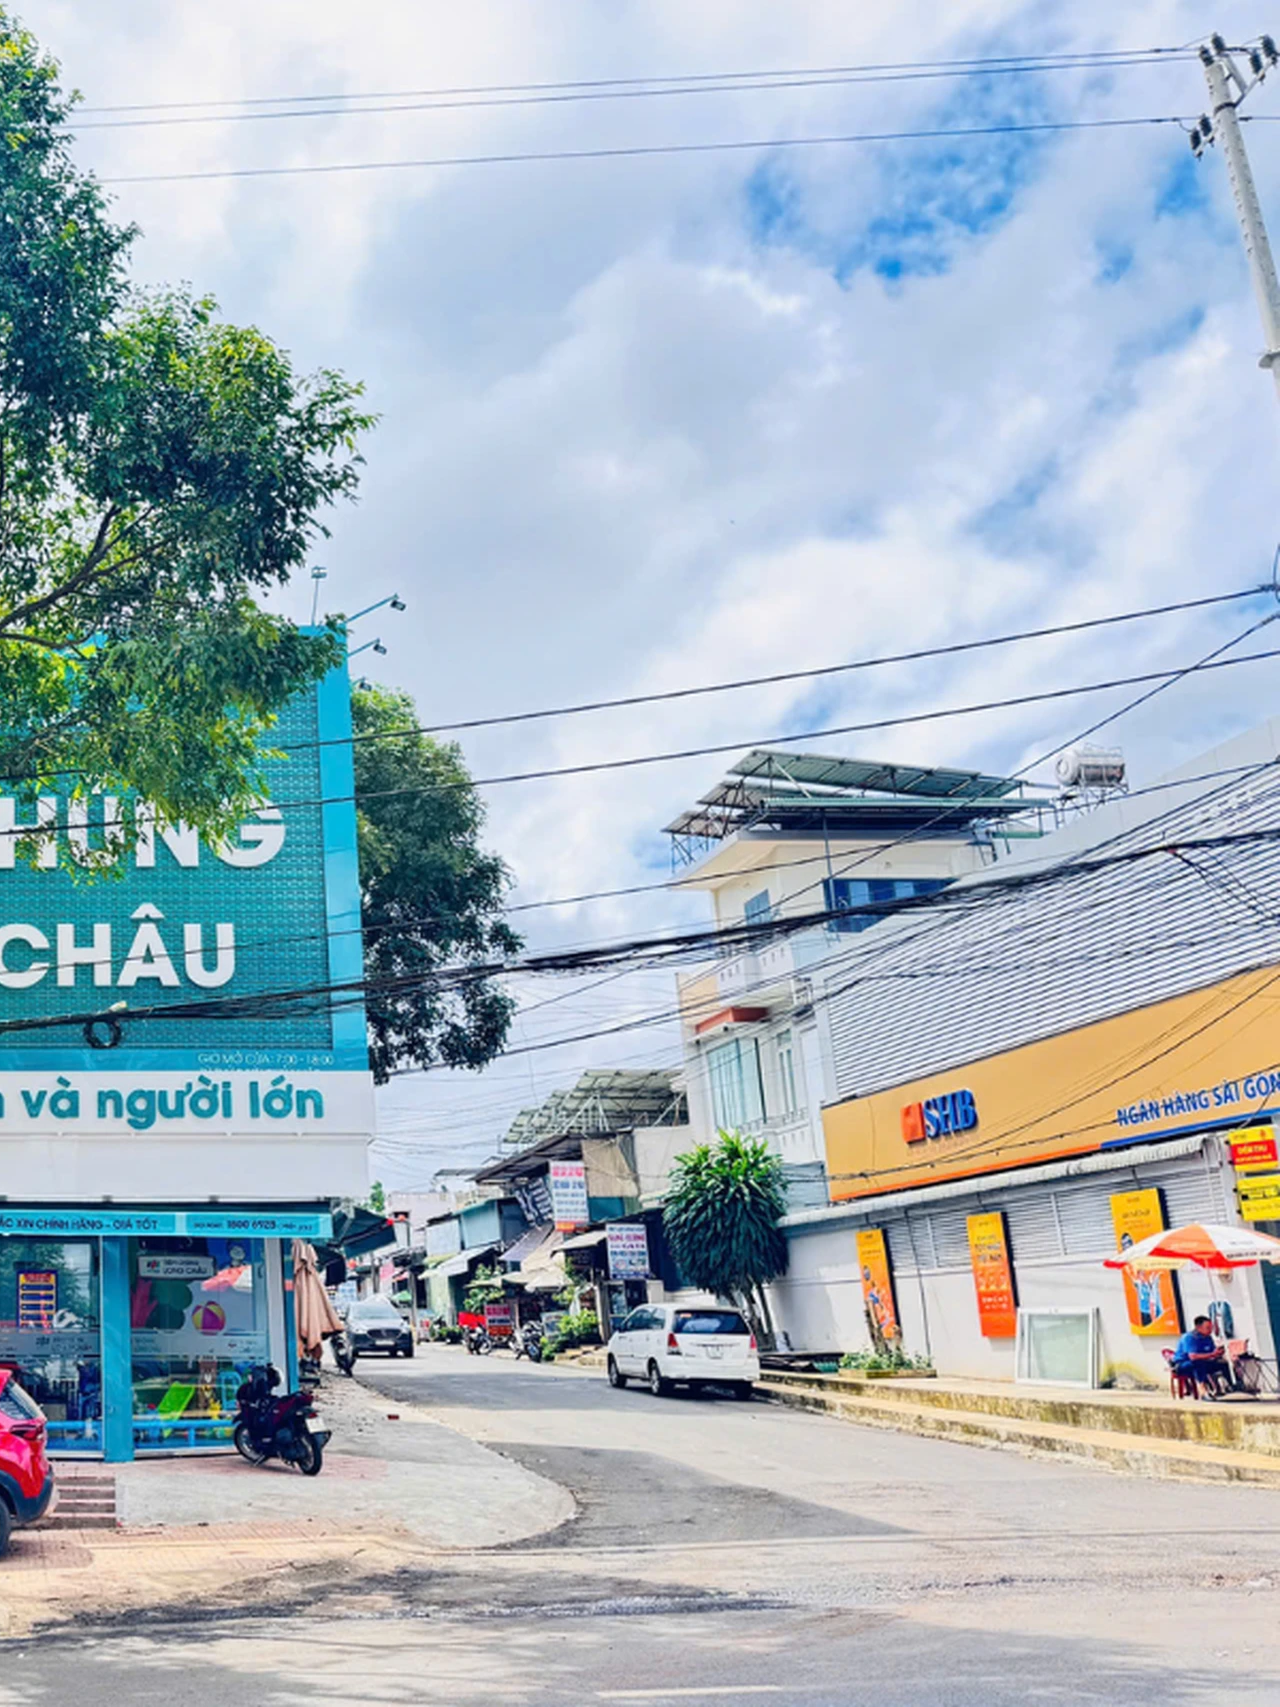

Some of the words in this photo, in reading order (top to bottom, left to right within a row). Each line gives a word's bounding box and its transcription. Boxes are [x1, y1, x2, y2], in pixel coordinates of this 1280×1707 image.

[20, 1074, 80, 1119] và
[97, 1074, 233, 1130] người
[249, 1074, 325, 1119] lớn
[923, 1089, 979, 1139] SHB
[1162, 1091, 1210, 1117] HÀNG
[17, 1217, 34, 1229] XIN
[36, 1216, 69, 1230] CHÍNH
[112, 1216, 133, 1230] GIÁ
[136, 1215, 159, 1230] TỐT
